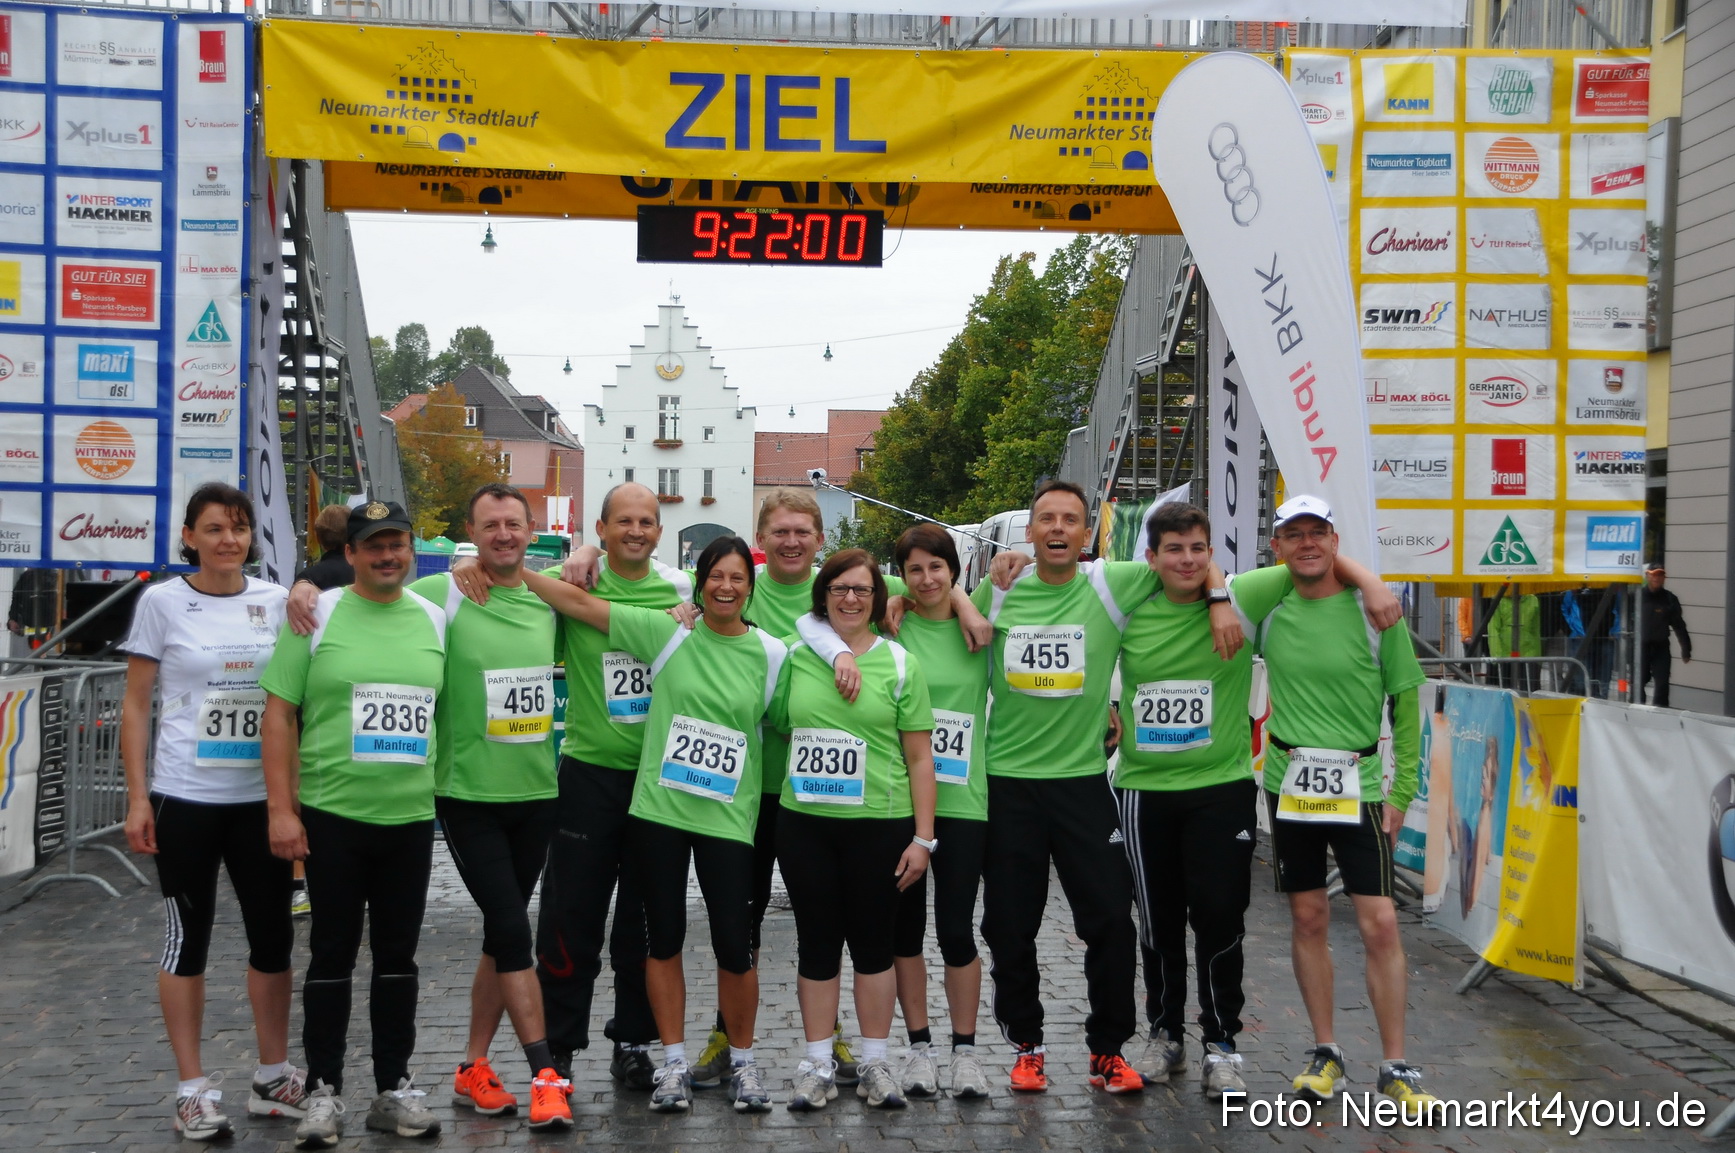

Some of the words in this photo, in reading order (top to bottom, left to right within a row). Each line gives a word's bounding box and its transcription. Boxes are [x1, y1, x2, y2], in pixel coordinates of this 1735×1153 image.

[199, 60, 225, 73] Braun
[1586, 69, 1611, 80] GUT
[1611, 67, 1634, 80] FÜR
[1295, 67, 1344, 86] Xplus1
[1489, 64, 1532, 92] RUND
[1387, 98, 1430, 110] KANN
[1489, 91, 1537, 114] SCHAU
[319, 98, 441, 124] Neumarkter
[445, 107, 540, 129] Stadtlauf
[665, 72, 887, 153] ZIEL
[0, 119, 25, 130] KK
[66, 120, 153, 147] Xplus1
[1009, 124, 1126, 142] Neumarkter
[1370, 158, 1415, 168] Neumarkter
[1415, 157, 1448, 169] Tagblatt
[1484, 162, 1540, 173] WITTMANN
[1490, 178, 1533, 193] VERPACKUNG
[1605, 173, 1632, 188] DEHN
[80, 194, 154, 208] INTERSPORT
[67, 206, 153, 223] HACKNER
[693, 211, 867, 261] 9:22:00
[1366, 227, 1451, 255] Charivari
[1575, 231, 1647, 255] Xplus1
[1488, 240, 1504, 248] TUI
[71, 270, 97, 282] GUT
[99, 270, 122, 283] FÜR
[124, 272, 148, 285] SIE!
[83, 294, 116, 302] Sparkasse
[1363, 308, 1421, 324] swn
[1469, 308, 1548, 328] NATHUS
[83, 350, 129, 374] maxi
[190, 362, 211, 371] Audi
[211, 362, 229, 370] BKK
[110, 384, 128, 398] dsl
[177, 381, 238, 402] Charivari
[1469, 383, 1516, 392] GERHART
[1390, 394, 1417, 402] MAX
[1421, 392, 1452, 402] BÖGL
[1489, 392, 1522, 400] JANIG
[1587, 397, 1636, 408] Neumarkter
[181, 412, 217, 423] swn
[1576, 407, 1641, 421] Lammsbräu
[6, 448, 40, 459] BÖGL
[75, 447, 136, 459] WITTMANN
[92, 459, 118, 467] DRUCK
[1575, 462, 1647, 474] HACKNER
[1491, 469, 1524, 485] Braun
[59, 512, 151, 541] Charivari
[1591, 521, 1637, 543] maxi
[1406, 536, 1435, 546] BKK
[1618, 553, 1635, 566] dsl
[1007, 632, 1032, 640] PARTL
[1033, 632, 1071, 640] Neumarkt
[604, 658, 631, 667] PARTL
[1020, 642, 1070, 670] 455
[225, 661, 255, 669] MERZ
[487, 677, 515, 685] PARTL
[516, 674, 545, 683] Neumarkt
[1034, 676, 1055, 687] Udo
[355, 691, 384, 699] PARTL
[386, 692, 423, 702] Neumarkt
[1137, 688, 1160, 697] PARTL
[1160, 687, 1198, 695] Neumarkt
[204, 698, 231, 706] PARTL
[504, 685, 545, 715] 456
[362, 702, 428, 734] 2836
[1140, 697, 1204, 725] 2828
[206, 709, 265, 737] 318
[508, 722, 543, 733] Werner
[672, 721, 698, 734] PARTL
[699, 728, 735, 744] Neumarkt
[793, 734, 815, 743] PARTL
[815, 735, 853, 745] Neumarkt
[1148, 729, 1195, 743] Christoph
[208, 742, 256, 756] AGNES
[374, 739, 417, 752] Manfred
[671, 734, 738, 774] 2835
[796, 745, 858, 775] 2830
[1309, 755, 1347, 766] Neumarkt
[685, 770, 712, 787] Ilona
[1294, 766, 1344, 795] 453
[802, 780, 845, 794] Gabriele
[1297, 799, 1338, 812] Thomas
